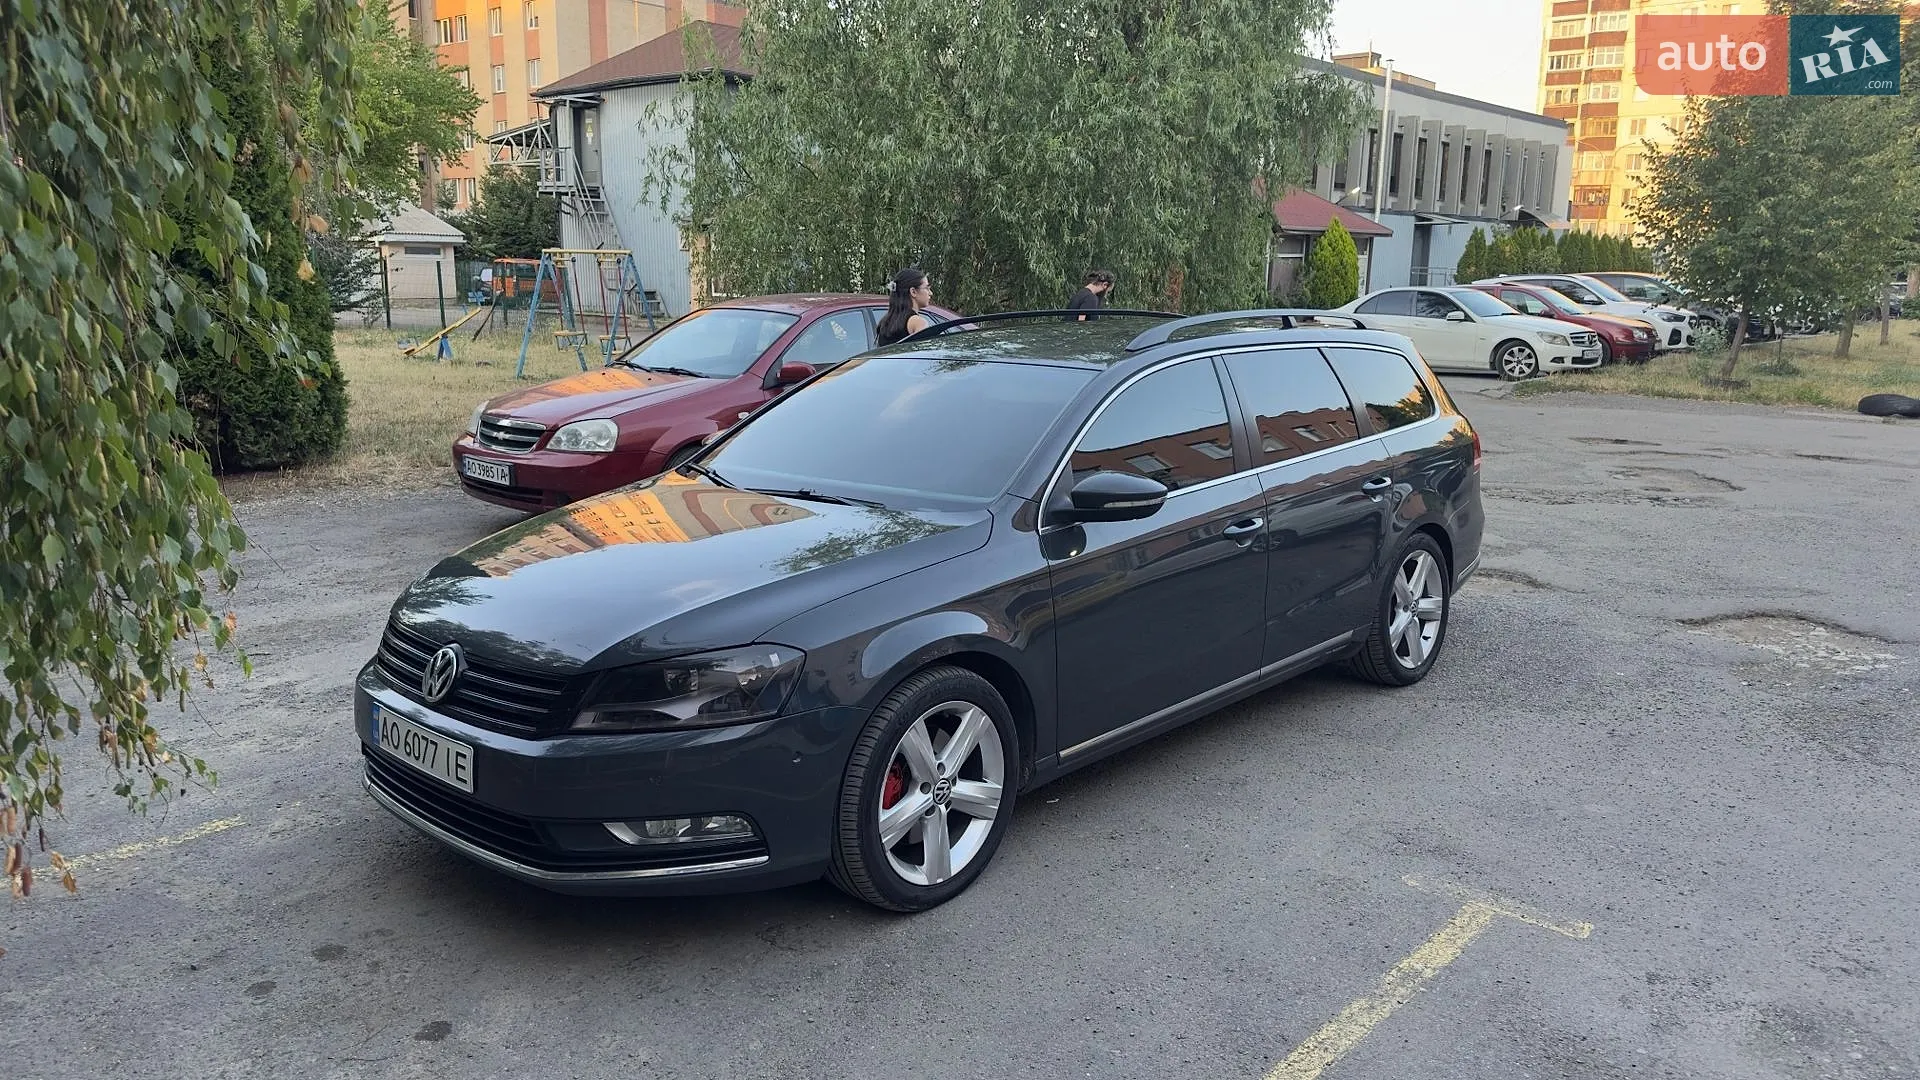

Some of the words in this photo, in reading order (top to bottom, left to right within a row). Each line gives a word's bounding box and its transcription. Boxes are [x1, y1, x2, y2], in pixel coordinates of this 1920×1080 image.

[467, 460, 477, 474] AO
[477, 463, 495, 479] 3985
[496, 467, 508, 482] IA
[381, 717, 400, 750] AO
[404, 729, 438, 769] 6077
[447, 747, 468, 785] IE
